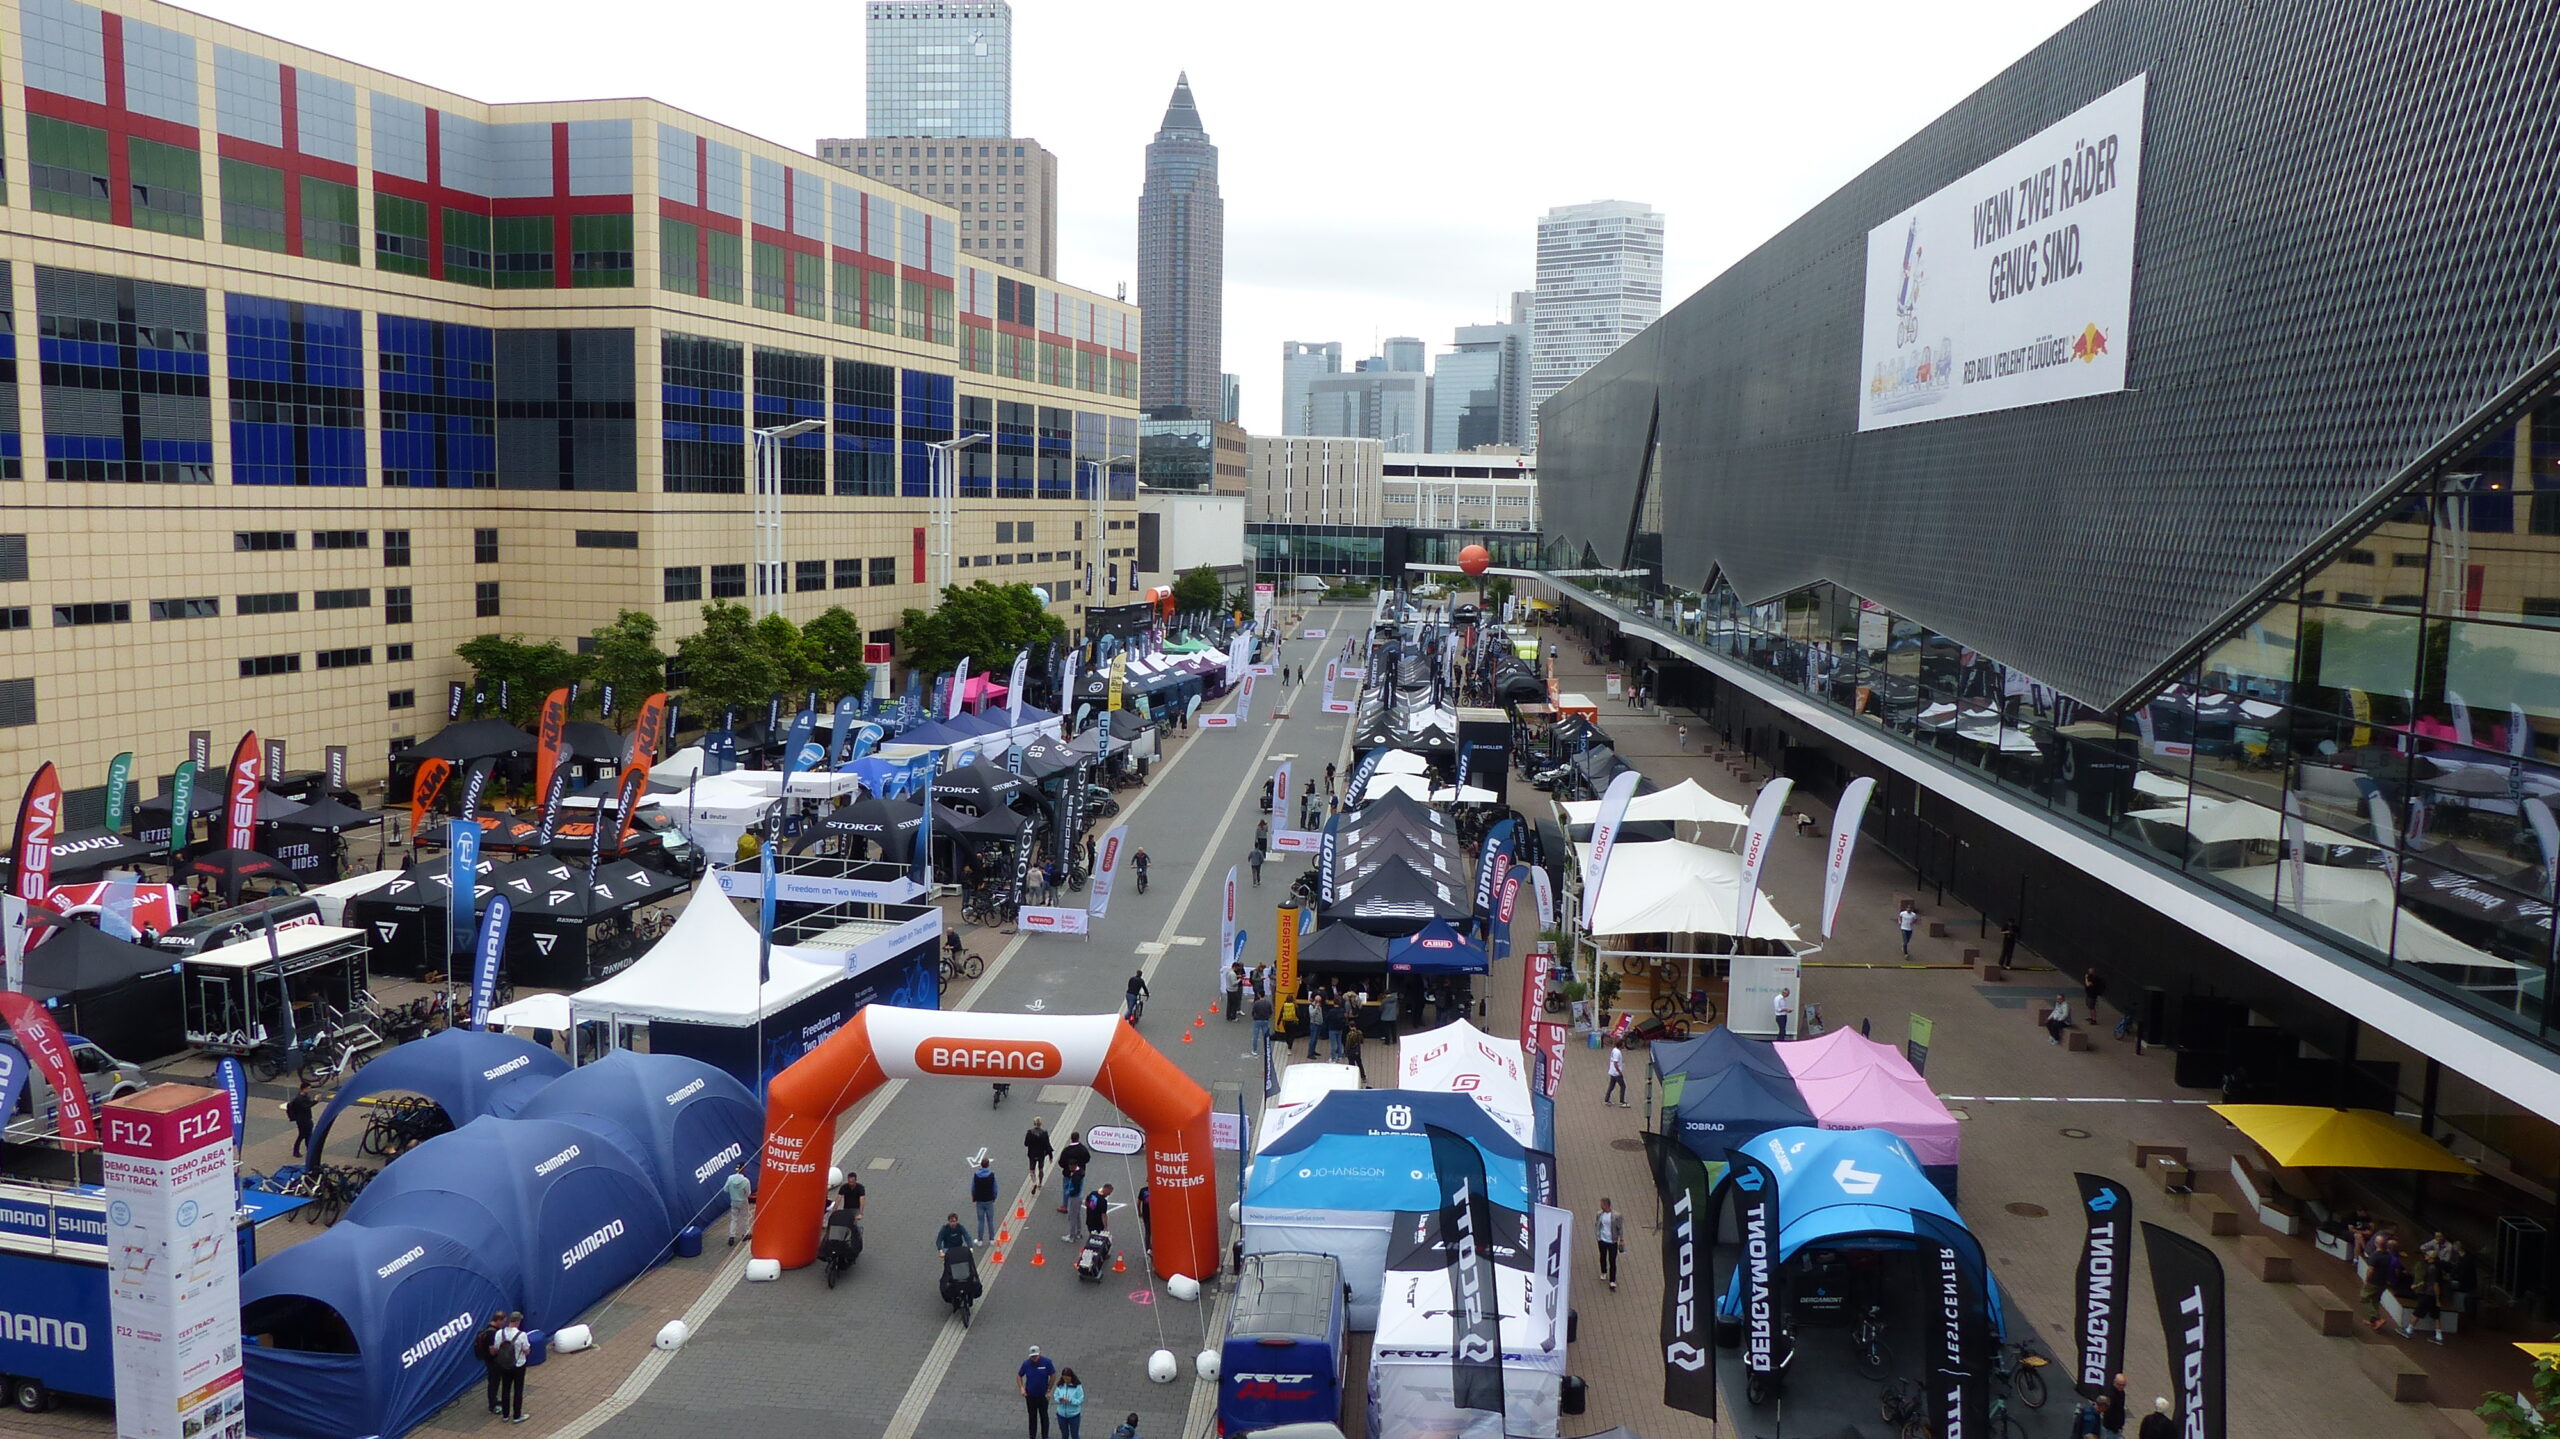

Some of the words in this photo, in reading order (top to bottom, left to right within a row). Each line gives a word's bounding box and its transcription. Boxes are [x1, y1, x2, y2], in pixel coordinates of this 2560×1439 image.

[1974, 186, 2014, 249] WENN
[2016, 164, 2056, 231] ZWEI
[2059, 134, 2118, 211] RÄDER
[1989, 240, 2037, 304] GENUG
[2041, 223, 2082, 287] SIND.
[1963, 360, 1977, 384] RED
[1976, 355, 1992, 382] BULL
[1994, 347, 2026, 378] VERLEIHT
[544, 701, 562, 752] KTM
[638, 704, 660, 757] KTM
[894, 695, 906, 738] TUNAP
[111, 763, 126, 817] owuru
[417, 763, 447, 807] KTM
[991, 779, 1022, 793] STORCK
[1344, 756, 1375, 808] pinion
[174, 772, 191, 826] owuru
[232, 757, 258, 850] SENA
[826, 820, 884, 832] STORCK
[23, 792, 56, 900] SENA
[50, 834, 120, 856] owuru
[1594, 825, 1610, 862] BOSCH
[1746, 831, 1762, 868] BOSCH
[1833, 831, 1849, 869] BOSCH
[291, 855, 319, 870] RIDES
[1013, 818, 1035, 904] STORCK
[1321, 832, 1334, 904] pinion
[1476, 837, 1501, 910] pinion
[787, 883, 821, 894] Freedom
[822, 887, 831, 895] on
[832, 887, 849, 896] Two
[850, 888, 878, 899] Wheels
[1501, 882, 1515, 917] ABUS
[159, 935, 195, 946] SENA
[1281, 914, 1292, 988] REGISTRATION
[1426, 940, 1448, 948] ABUS
[475, 902, 504, 1026] SHIMANO
[1526, 955, 1549, 1055] GASGAS
[802, 1015, 831, 1039] Freedom
[831, 1011, 841, 1023] on
[802, 1035, 816, 1051] Two
[483, 1054, 530, 1081] SHIMANO
[932, 1047, 1045, 1071] BAFANG
[665, 1077, 706, 1106] SHIMANO
[111, 1119, 153, 1147] F12
[179, 1108, 221, 1144] F12
[769, 1133, 804, 1148] E-BIKE
[1093, 1129, 1114, 1138] SLOW
[1114, 1132, 1138, 1140] PLEASE
[1212, 1129, 1229, 1137] Drive
[1685, 1122, 1725, 1131] JOBRAD
[768, 1146, 800, 1160] DRIVE
[1091, 1139, 1121, 1147] LANGSAM
[1154, 1151, 1190, 1162] E-BIKE
[104, 1160, 130, 1172] DEMO
[132, 1163, 157, 1176] AREA
[170, 1158, 199, 1176] DEMO
[200, 1148, 225, 1163] AREA
[171, 1171, 195, 1187] TEST
[196, 1158, 227, 1177] TRACK
[535, 1144, 581, 1177] SHIMANO
[695, 1142, 742, 1185] SHIMANO
[766, 1158, 816, 1174] SYSTEMS
[1155, 1163, 1188, 1174] DRIVE
[105, 1171, 126, 1181] TEST
[127, 1174, 159, 1187] TRACK
[1156, 1174, 1205, 1187] SYSTEMS
[561, 1218, 625, 1271] SHIMANO
[377, 1245, 425, 1279] SHIMANO
[1407, 1276, 1419, 1309] FELT
[1524, 1275, 1533, 1316] FELT
[116, 1325, 133, 1337] F12
[178, 1326, 194, 1339] TEST
[194, 1317, 215, 1331] TRACK
[401, 1311, 473, 1369] SHIMANO
[1379, 1350, 1449, 1358] FELT
[1233, 1372, 1314, 1384] FELT
